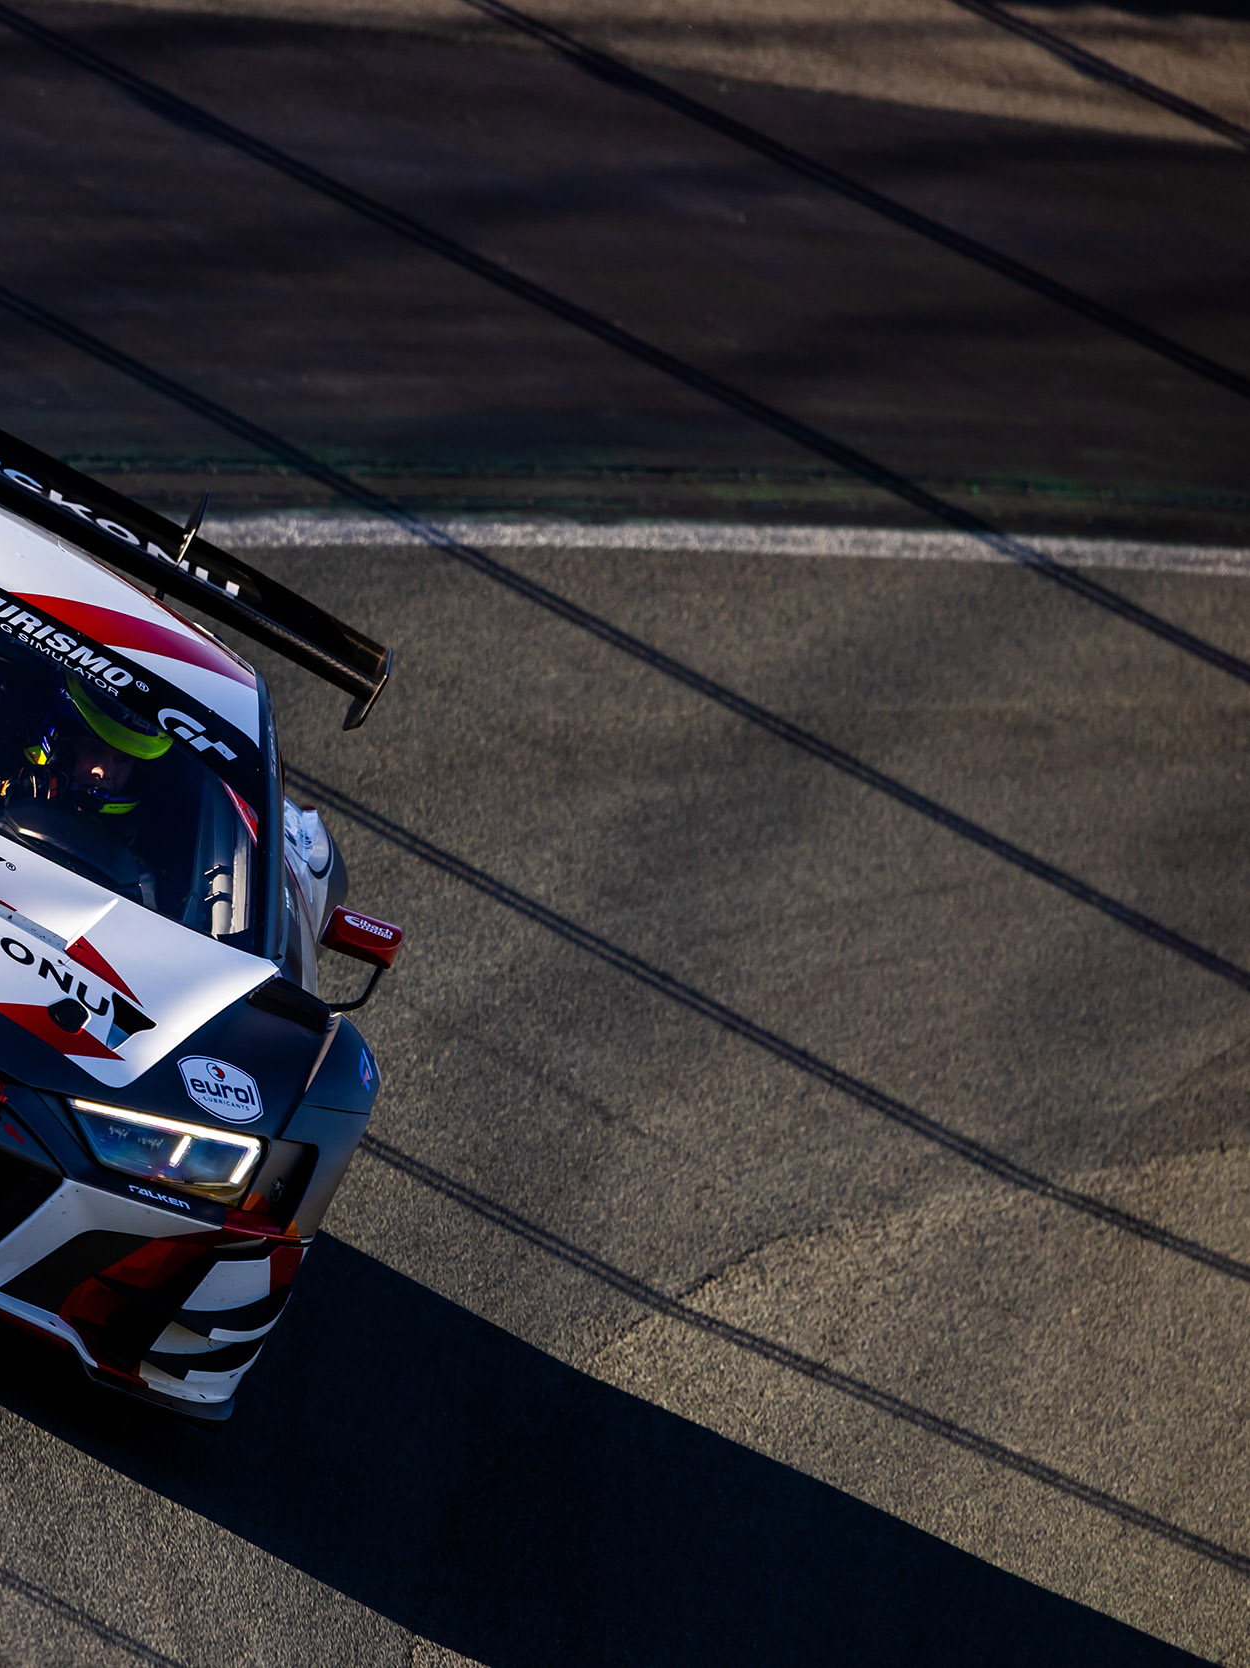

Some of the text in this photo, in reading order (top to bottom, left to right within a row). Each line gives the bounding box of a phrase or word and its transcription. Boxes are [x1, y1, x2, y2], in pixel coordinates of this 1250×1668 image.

[17, 632, 120, 697] SIMULATOR
[190, 1078, 256, 1106] eurol
[202, 1096, 250, 1111] LUBRICANTS
